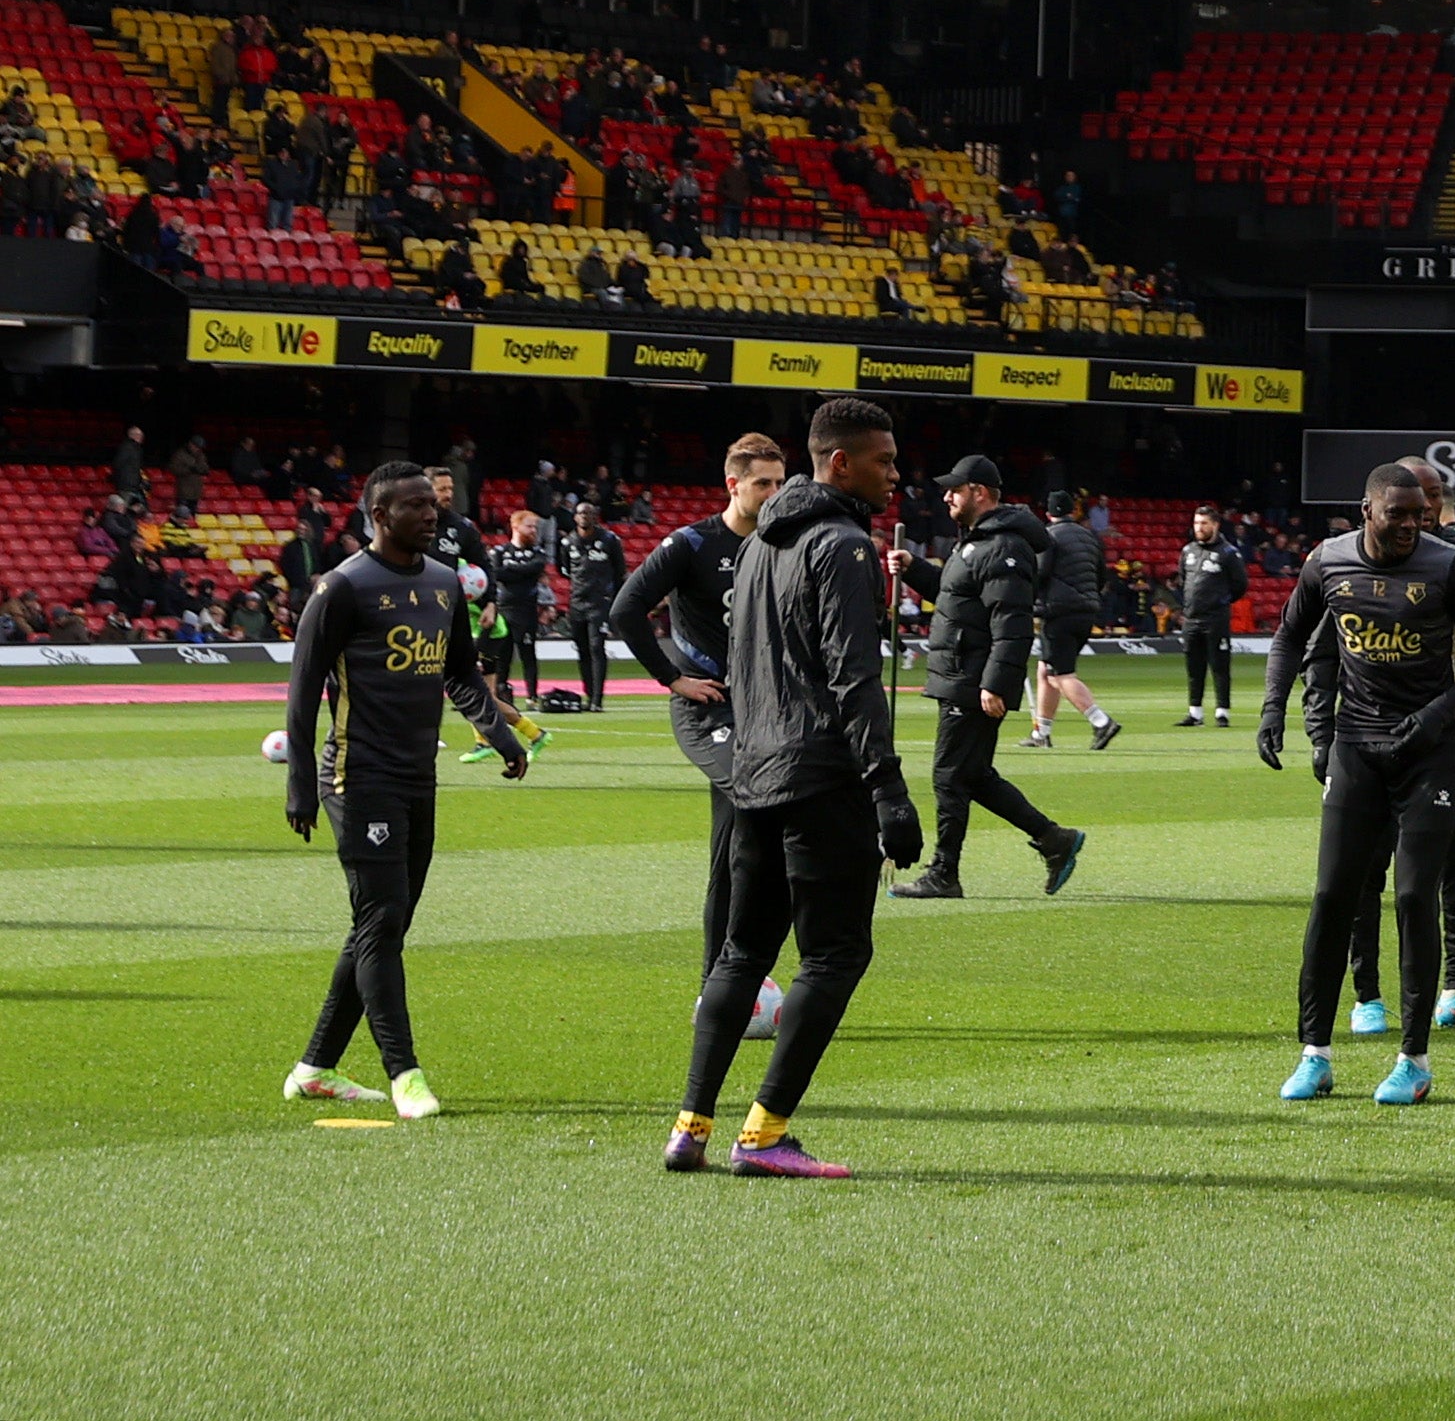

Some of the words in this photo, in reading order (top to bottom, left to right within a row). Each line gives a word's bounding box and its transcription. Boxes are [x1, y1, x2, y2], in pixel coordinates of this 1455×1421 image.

[203, 320, 254, 354] Stake
[275, 321, 320, 356] We
[367, 331, 444, 360] Equality
[502, 339, 578, 364] Together
[633, 344, 709, 373] Diversity
[769, 353, 821, 376] Family
[859, 357, 971, 382] Empowerment
[1001, 365, 1061, 388] Respect
[1108, 370, 1175, 393] Inclusion
[1206, 372, 1240, 401] We
[1253, 375, 1291, 404] Stake
[386, 624, 447, 672] Stak
[1340, 612, 1422, 656] Stake
